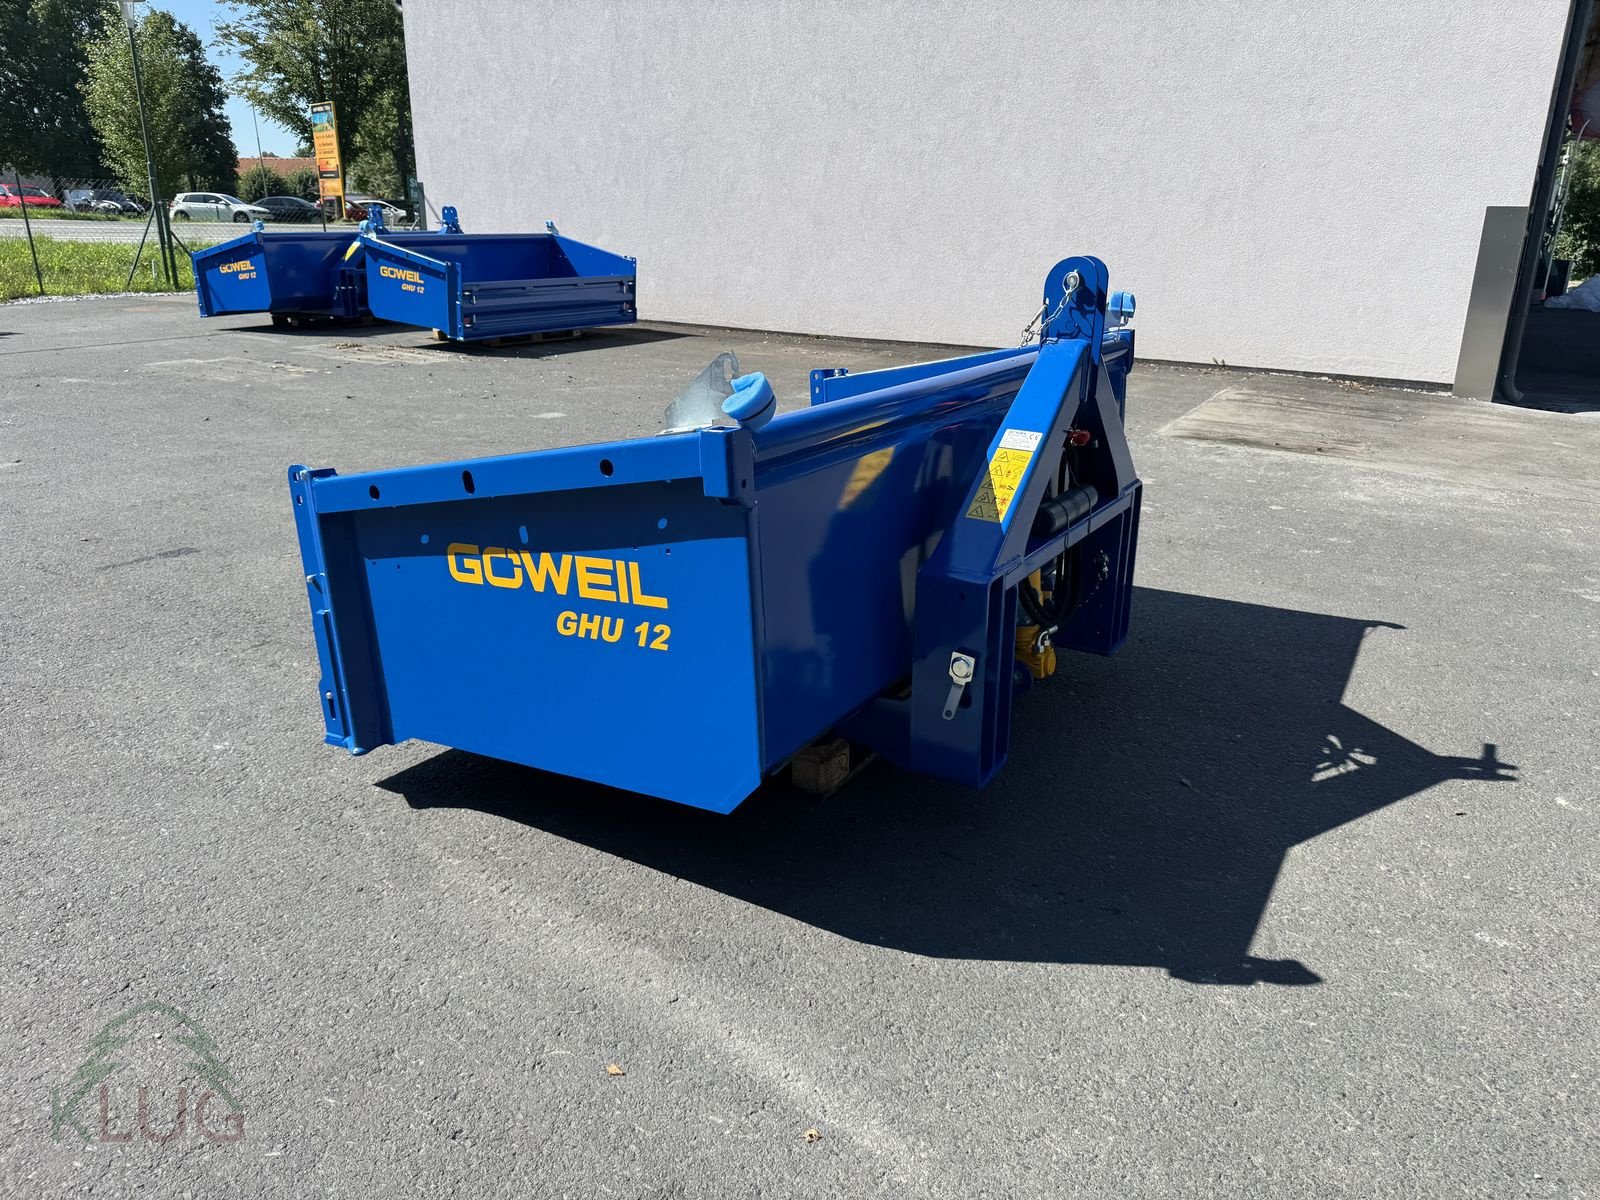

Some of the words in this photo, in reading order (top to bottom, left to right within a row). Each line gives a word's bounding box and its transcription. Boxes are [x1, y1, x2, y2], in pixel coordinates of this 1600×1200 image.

[401, 283, 416, 292] GHU
[416, 286, 425, 294] 12
[556, 610, 624, 643] GHU
[635, 621, 672, 651] 12
